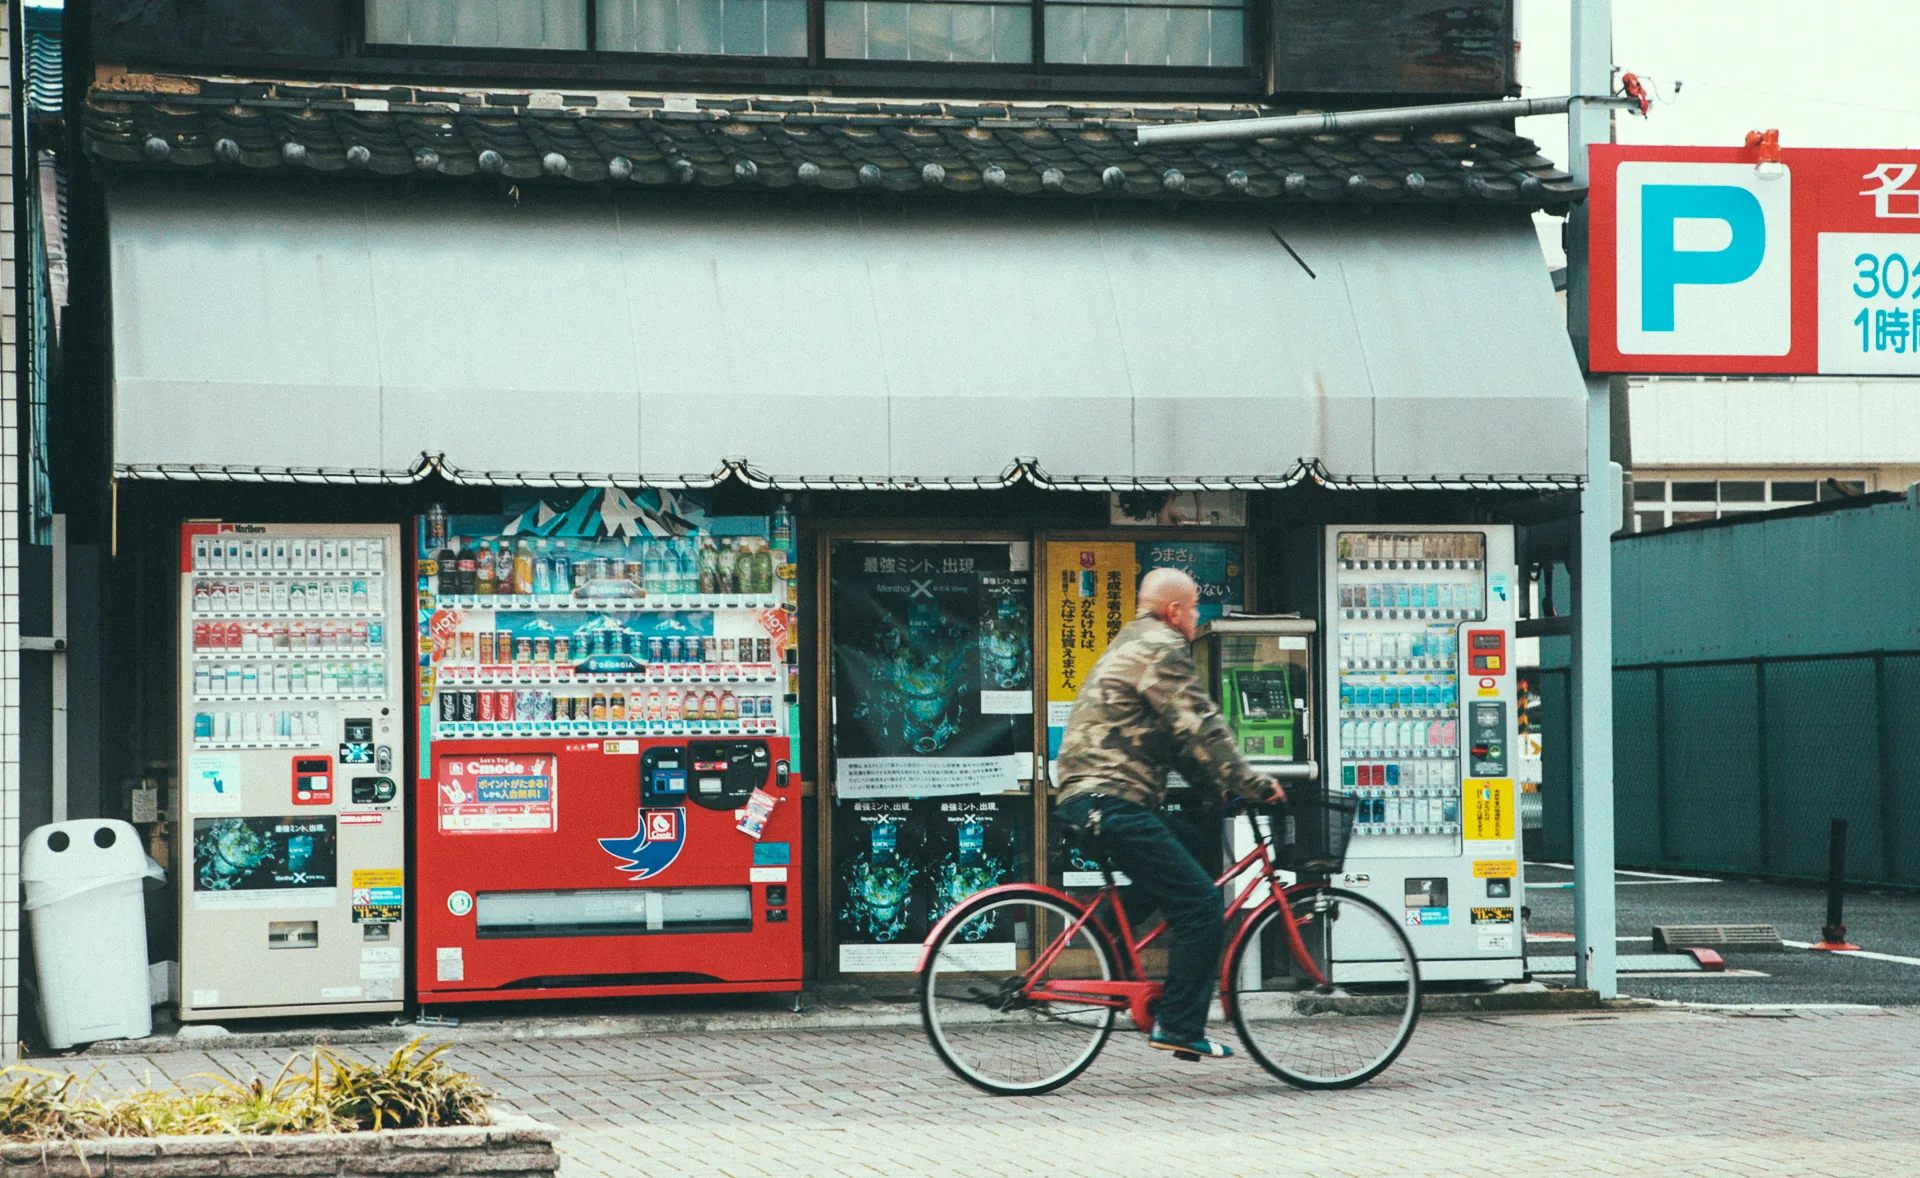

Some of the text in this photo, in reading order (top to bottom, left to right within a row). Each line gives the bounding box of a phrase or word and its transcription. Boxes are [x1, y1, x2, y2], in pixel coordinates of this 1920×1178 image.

[1859, 163, 1920, 218] 名
[1641, 184, 1766, 332] P
[1853, 253, 1920, 299] 30
[1854, 307, 1920, 353] 1時
[234, 524, 266, 534] Marlboro
[1150, 547, 1197, 563] うまさも
[877, 584, 910, 593] Menthol
[910, 579, 934, 598] X
[1106, 570, 1122, 645] 未成年者の喫煙
[432, 611, 457, 635] HOT
[764, 609, 786, 633] HOT
[1080, 599, 1096, 652] がなければ、
[598, 661, 634, 669] GEORGIA
[466, 761, 525, 775] Cmode
[877, 813, 890, 824] X
[964, 813, 976, 824] X
[292, 872, 307, 884] X
